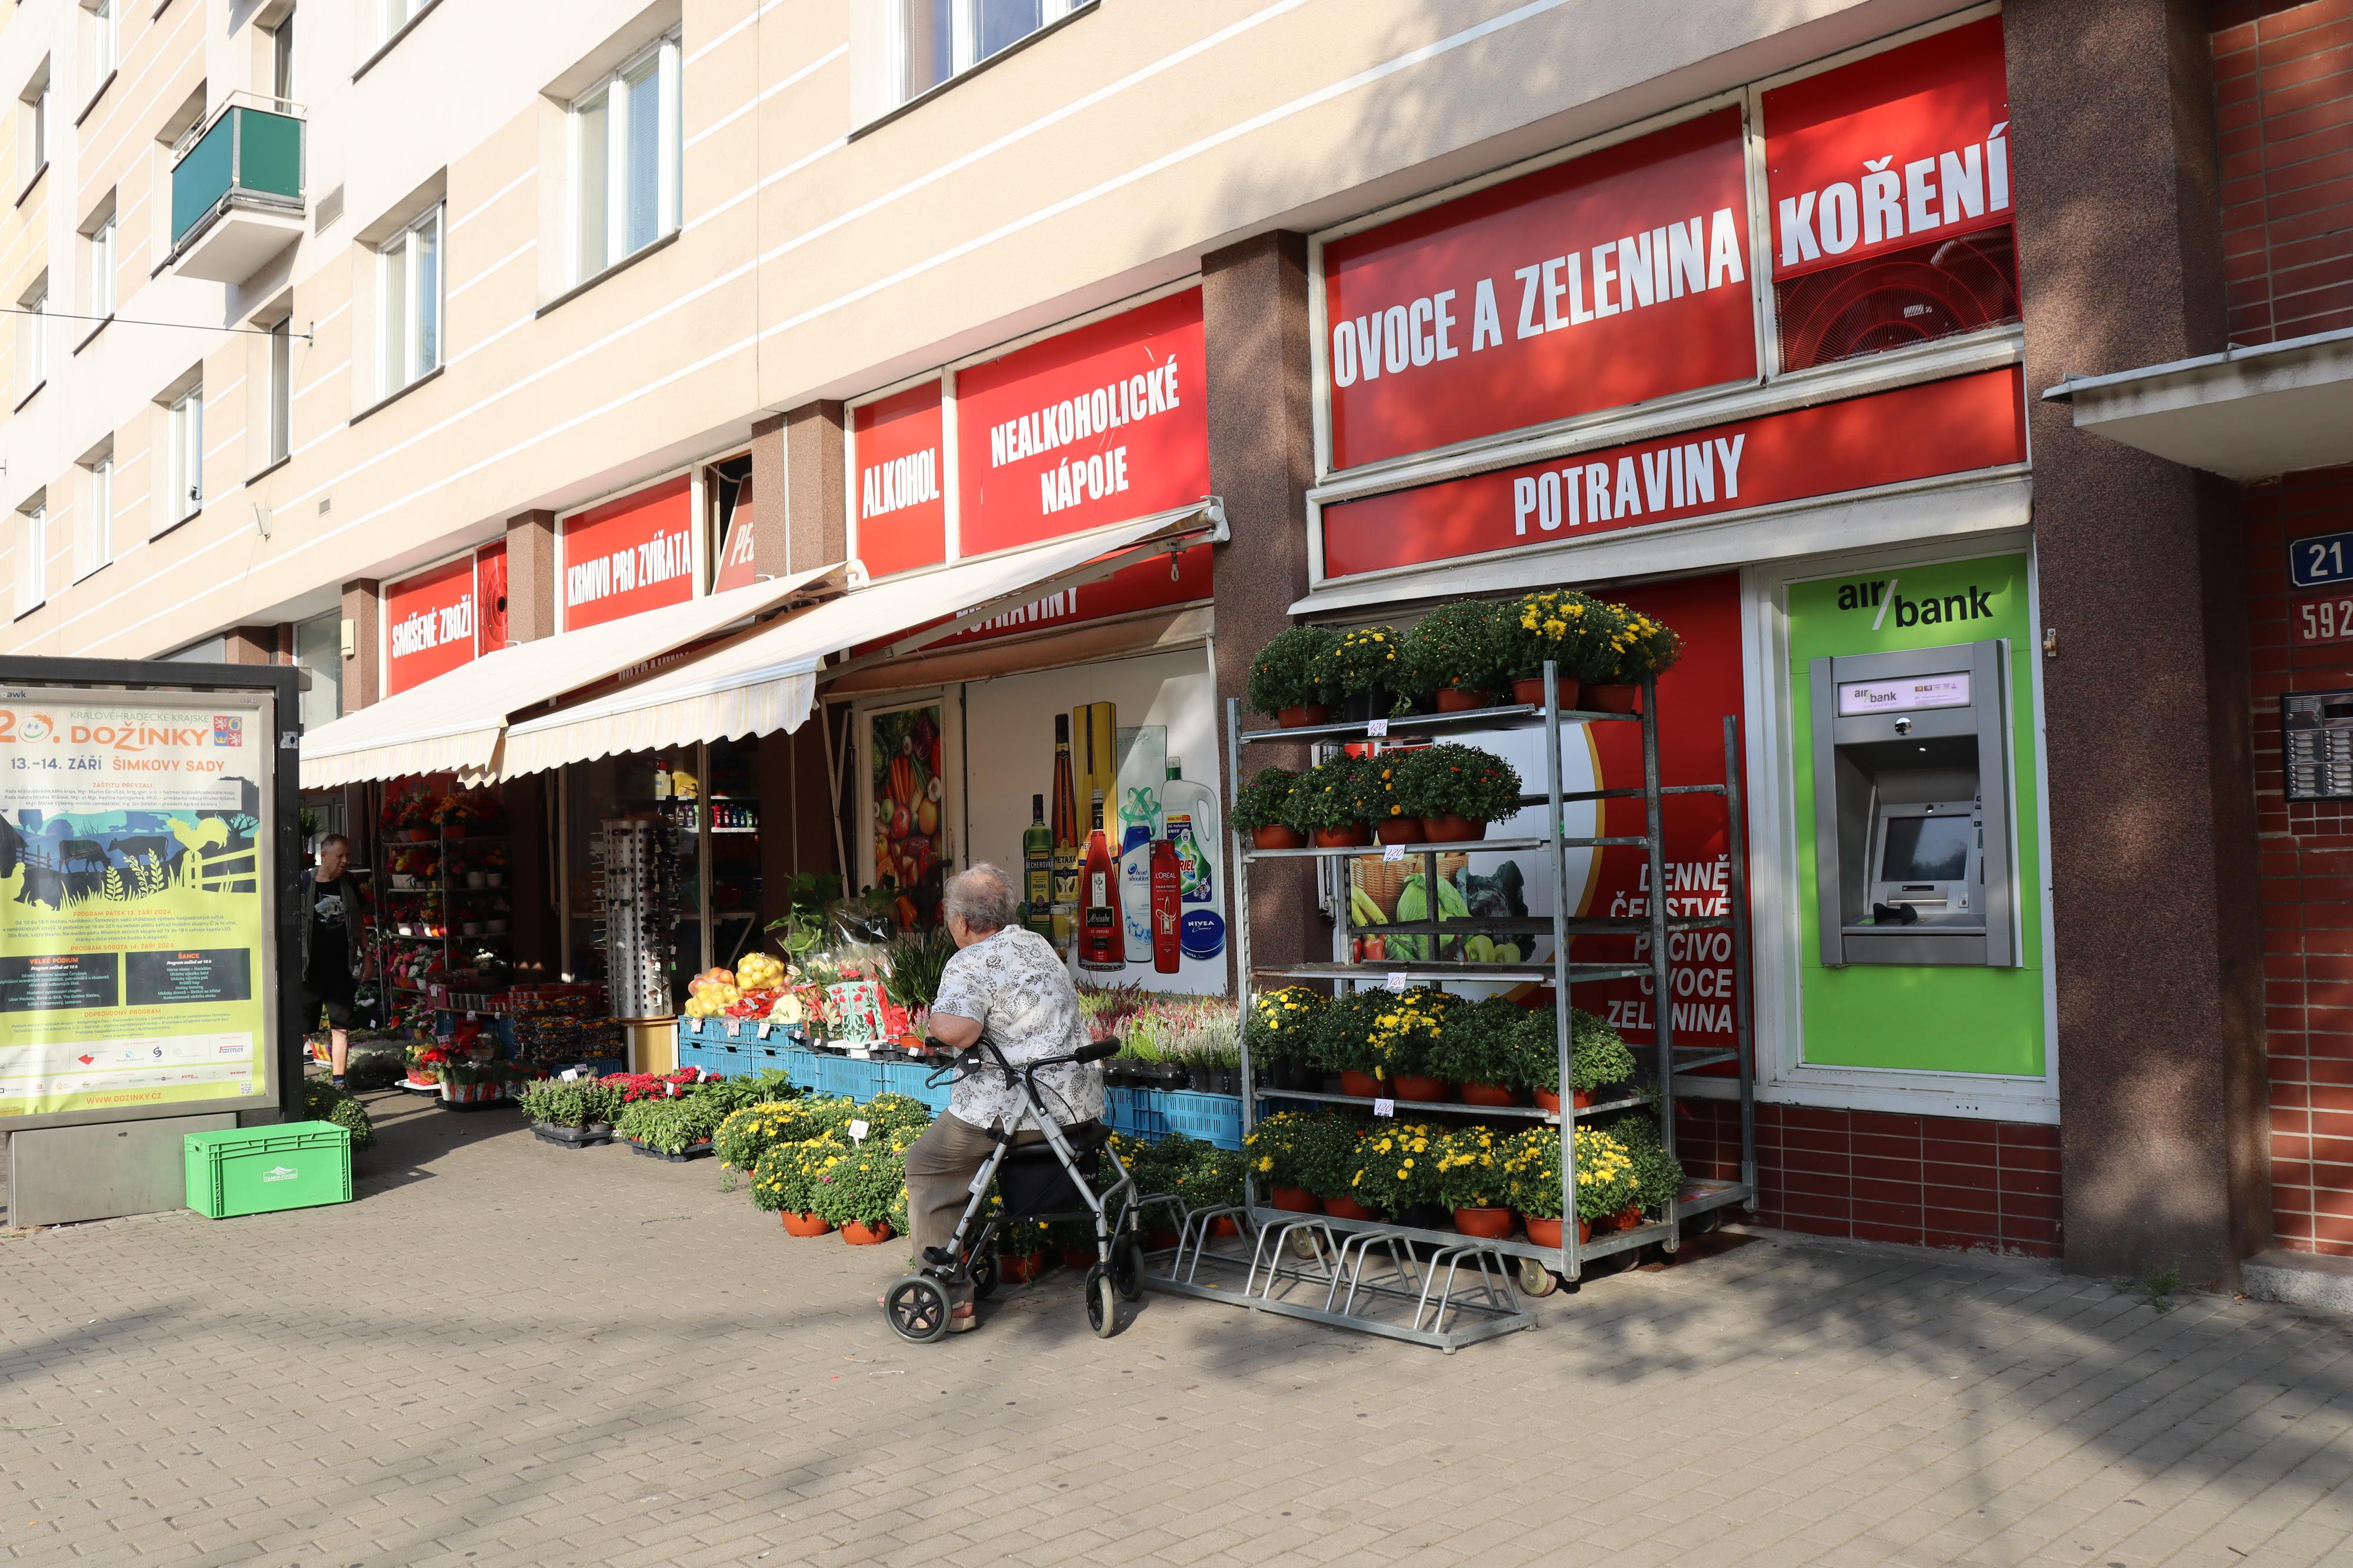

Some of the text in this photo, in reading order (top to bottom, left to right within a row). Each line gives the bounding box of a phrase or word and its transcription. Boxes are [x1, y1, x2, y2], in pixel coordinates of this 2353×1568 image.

[1779, 121, 2009, 268] KOŘENÍ
[1333, 207, 1745, 388] OVOCE A ZELENINA
[991, 353, 1180, 468] NEALKOHOLICKÉ
[862, 447, 940, 519] ALKOHOL
[1041, 445, 1129, 516] NÁPOJE
[1513, 433, 1745, 536] POTRAVINY
[568, 529, 692, 608] KRMIVO PRO ZVÍŘATA
[2308, 541, 2343, 577] 21
[392, 594, 472, 659] SMÍŠENÉ ZBOŽÍ
[71, 721, 209, 752] DOŽÍNKY
[1370, 722, 1386, 731] 120
[68, 755, 102, 770] ZÁŘÍ
[112, 755, 181, 772] ŠIMKOVY
[186, 760, 225, 772] SADY
[1054, 856, 1076, 864] METAXA
[1179, 860, 1195, 871] RIEL
[1386, 848, 1404, 857] 120
[1610, 889, 1731, 918] ČESTVÉ
[1634, 930, 1732, 962] PČIVO
[1389, 976, 1405, 985] 120
[85, 1008, 127, 1017] DOPROVODNÝ
[1607, 1000, 1733, 1033] ZELNINA
[219, 1045, 244, 1053] Farmet
[86, 1092, 162, 1105] WWW.DOZINKY.CZ
[1377, 1103, 1392, 1112] 120
